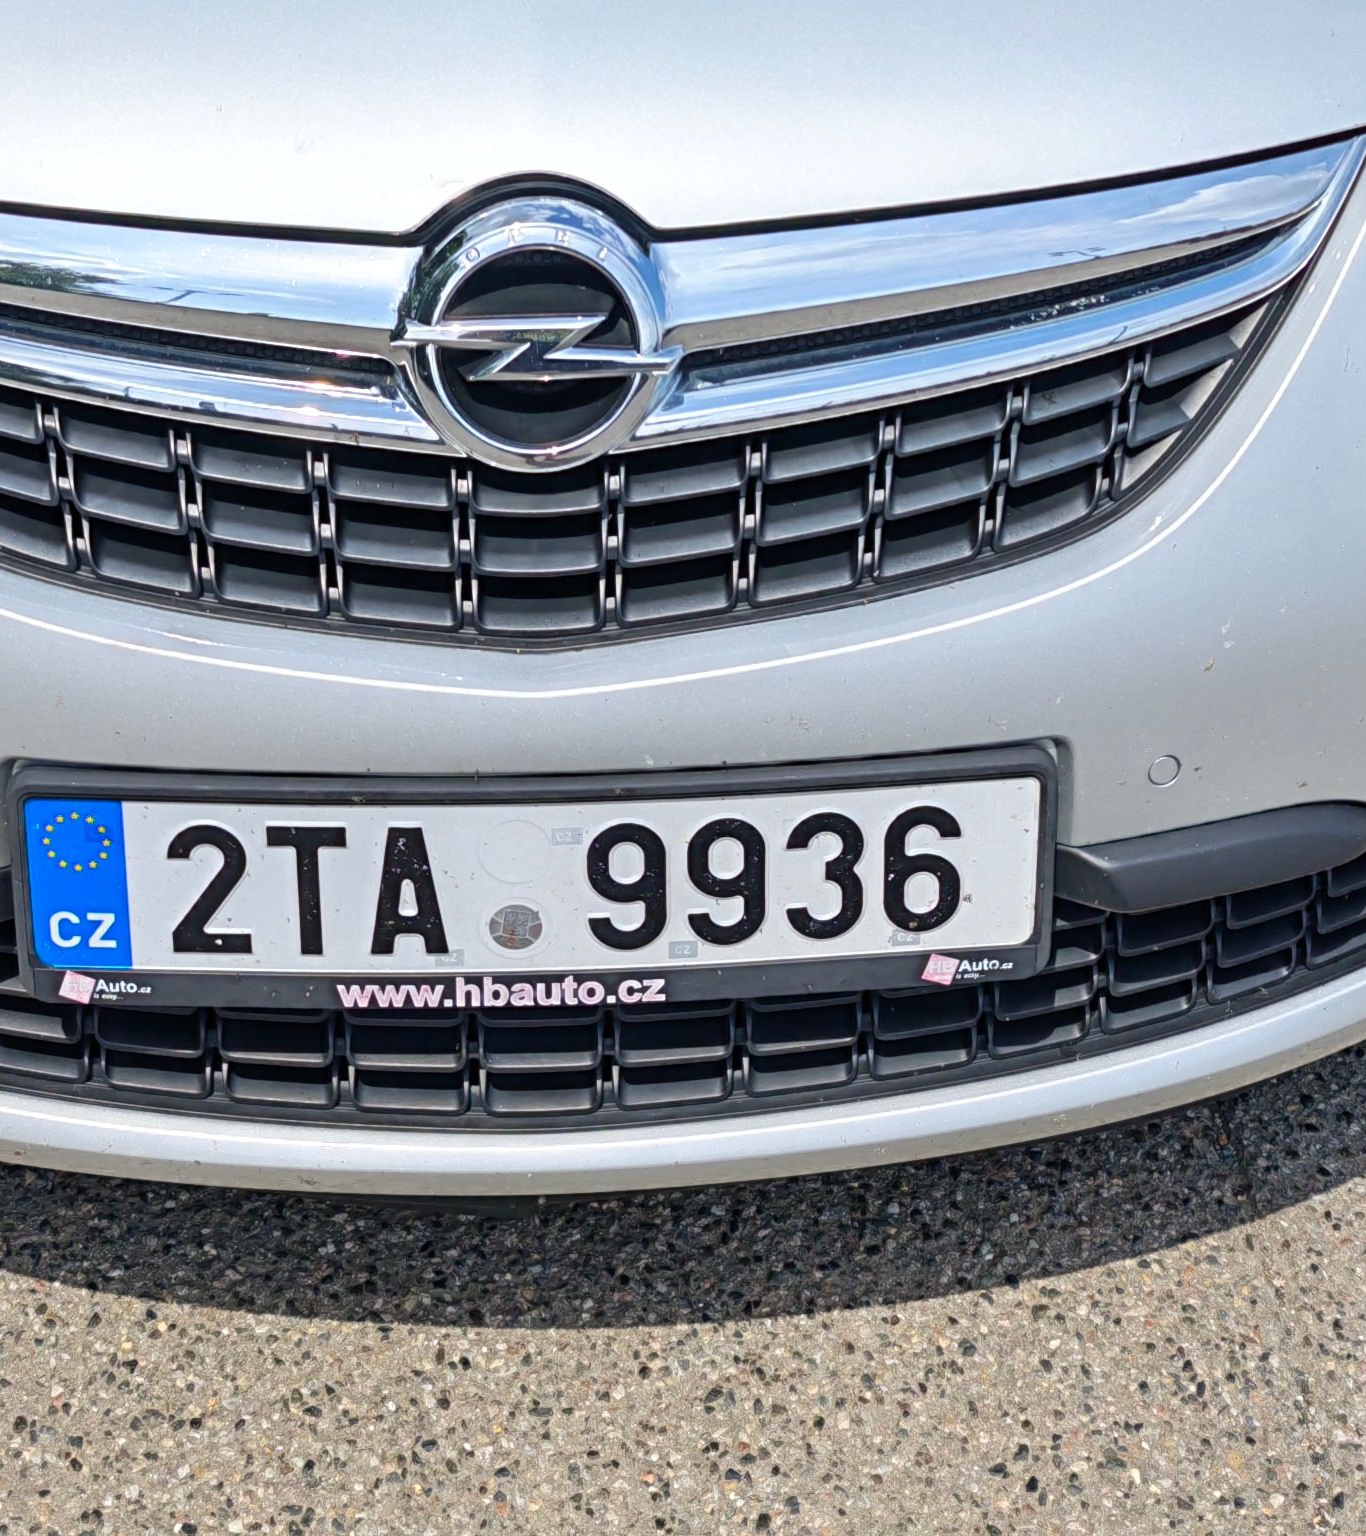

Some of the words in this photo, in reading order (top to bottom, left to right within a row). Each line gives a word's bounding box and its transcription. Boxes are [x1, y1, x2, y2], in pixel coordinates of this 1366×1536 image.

[167, 823, 449, 955] 2TA
[587, 805, 961, 950] 9936
[49, 911, 117, 949] CZ
[336, 975, 666, 1008] www.hbauto.cz
